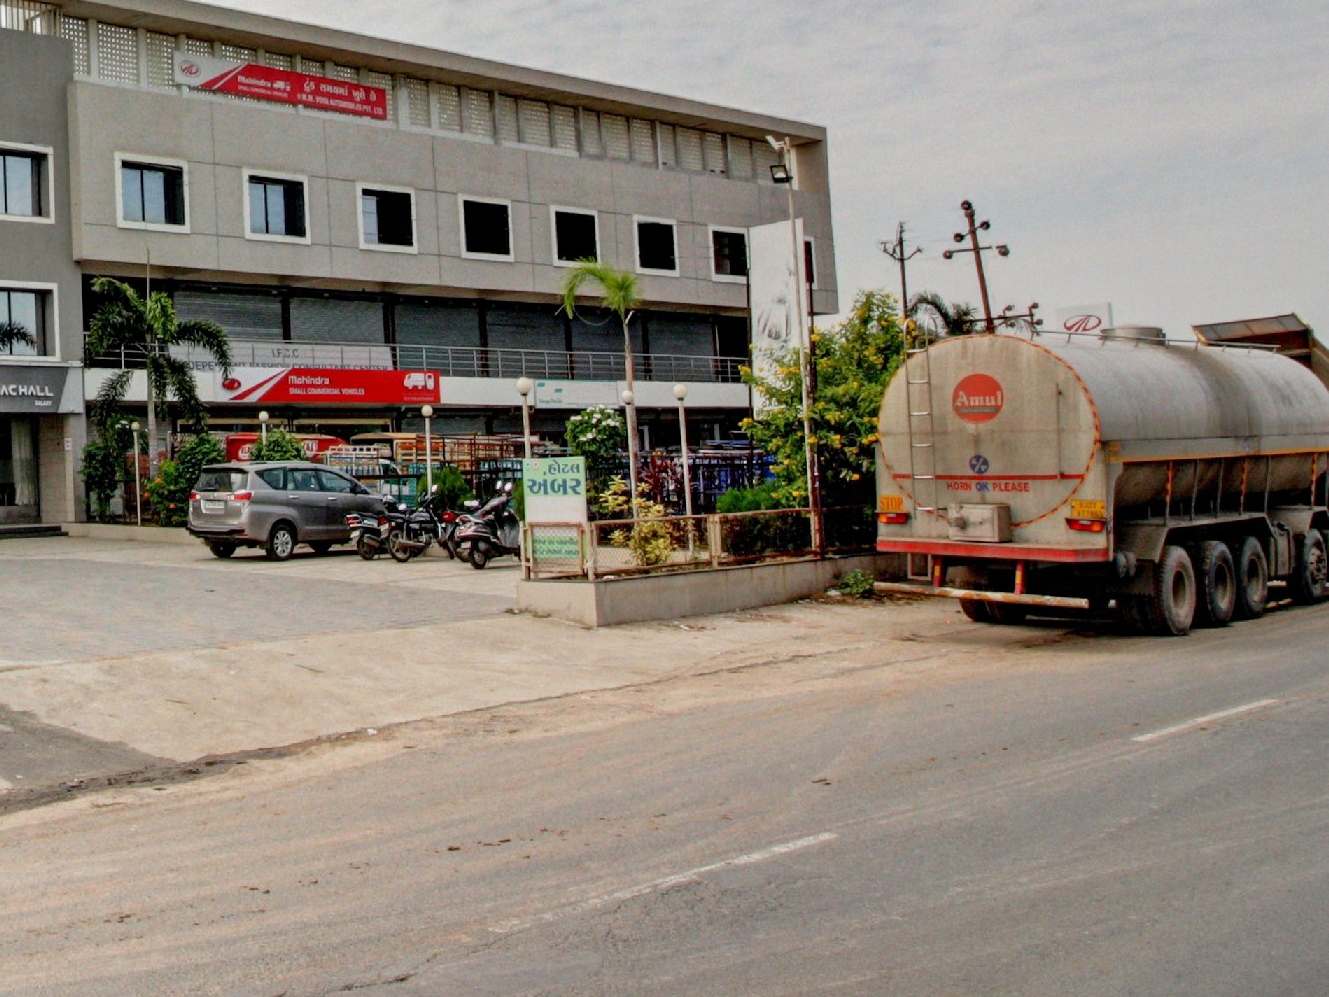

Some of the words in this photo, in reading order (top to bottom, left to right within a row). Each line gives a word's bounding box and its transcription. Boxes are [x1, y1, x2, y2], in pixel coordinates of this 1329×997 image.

[288, 375, 330, 385] Mahindra
[954, 390, 1002, 406] Amul
[947, 482, 971, 491] HORN
[975, 482, 989, 492] OK
[992, 482, 1030, 492] PLEASE
[880, 497, 903, 511] STOP
